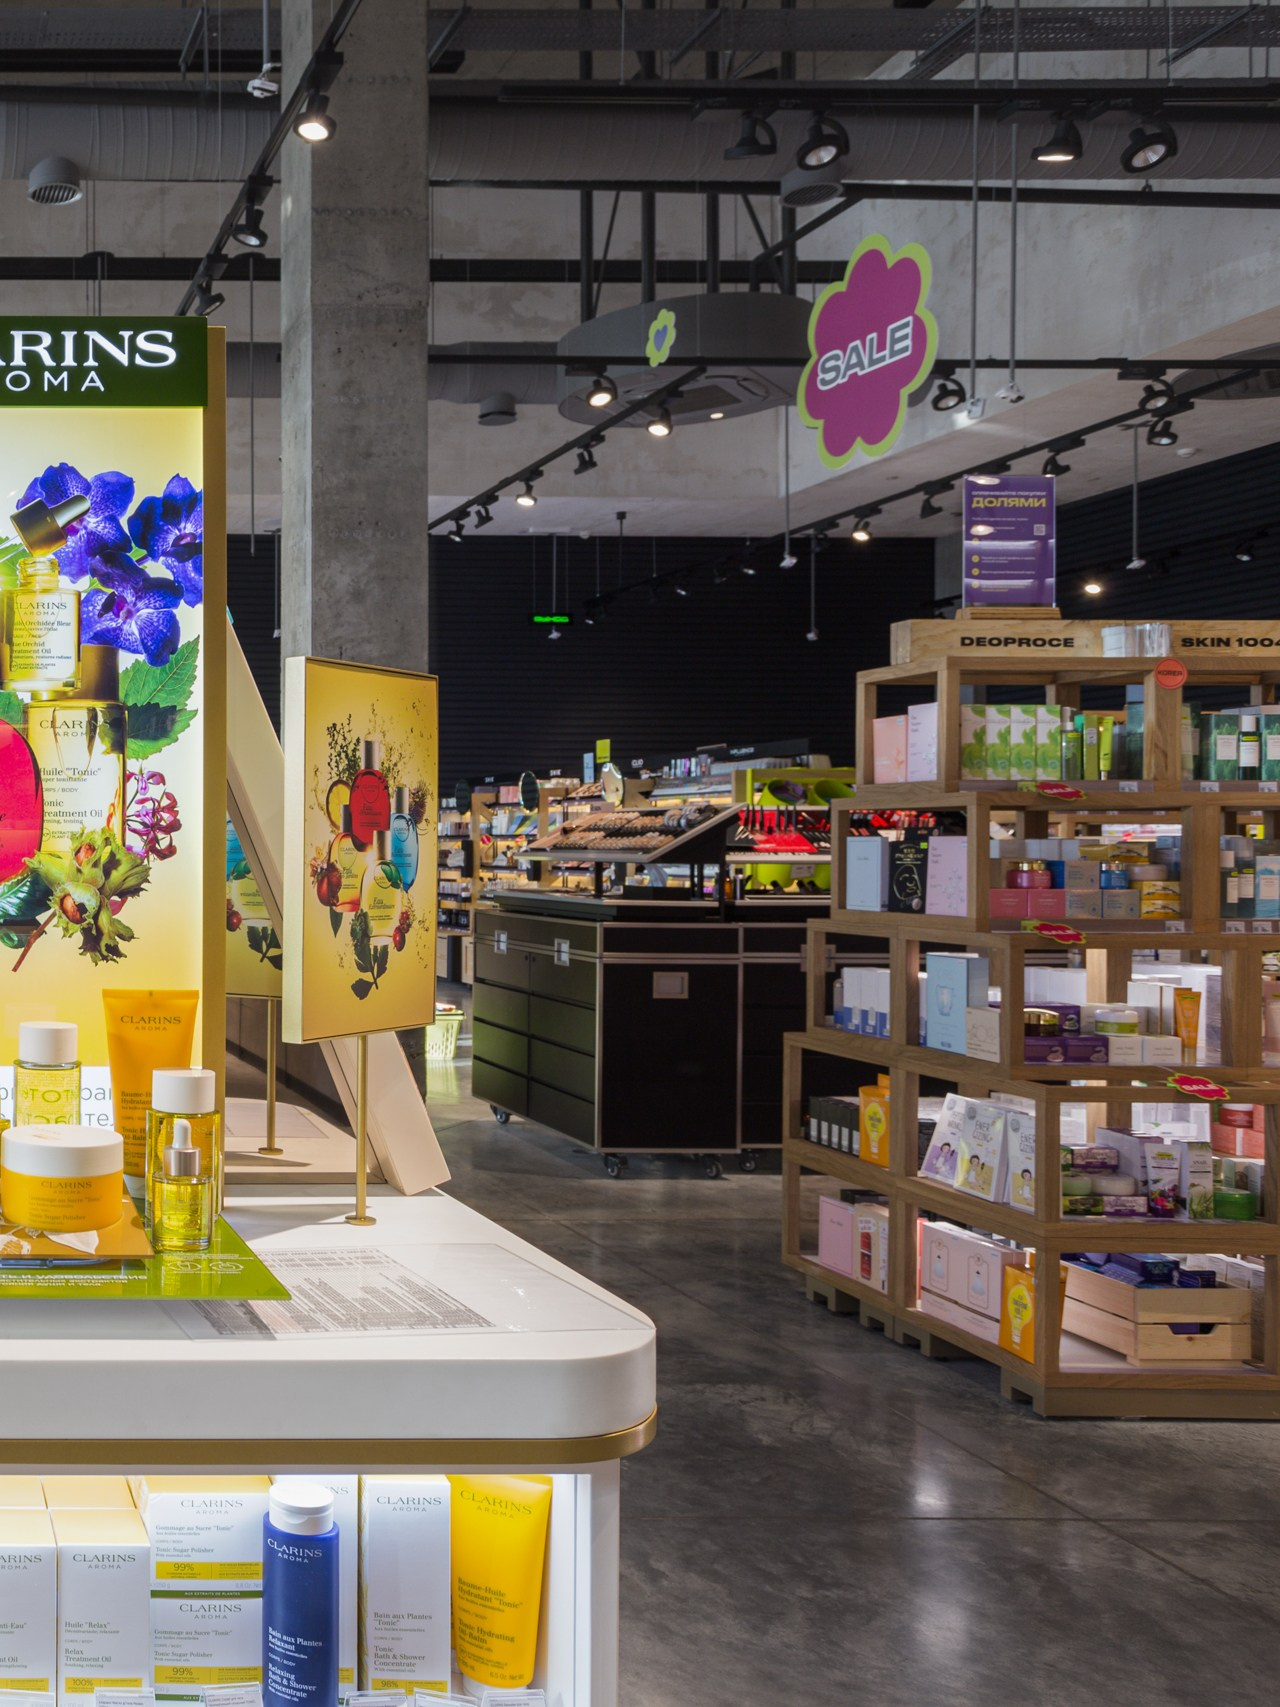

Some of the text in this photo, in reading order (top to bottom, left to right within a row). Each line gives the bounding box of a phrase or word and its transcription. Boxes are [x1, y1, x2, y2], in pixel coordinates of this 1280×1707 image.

[817, 316, 914, 390] SALE
[972, 497, 1046, 508] ДОЛЯМИ
[960, 636, 1075, 648] DEOPROCE
[1180, 637, 1231, 648] SKIN
[43, 799, 64, 807] onic
[44, 809, 103, 818] reatment Oil
[120, 1016, 181, 1025] CLARINS
[41, 1181, 93, 1189] CLARINS
[181, 1500, 243, 1508] CLARINS
[376, 1496, 442, 1506] CLARINS
[460, 1490, 532, 1515] CLARINS
[476, 1506, 514, 1519] AROMA
[267, 1538, 323, 1558] CLARINS
[73, 1554, 136, 1562] CLARINS
[278, 1553, 309, 1564] AROMA
[174, 1564, 195, 1572] 99%
[180, 1604, 242, 1613] CLARINS
[374, 1619, 400, 1627] "Tonic"
[268, 1634, 296, 1651] Relaxant
[374, 1652, 391, 1660] Bath
[400, 1653, 426, 1661] Shower
[374, 1660, 417, 1668] Concentrate
[173, 1668, 193, 1676] 99%
[268, 1663, 296, 1681] Relaxing
[268, 1671, 317, 1692] Bath & Shower
[381, 1680, 398, 1688] 98%
[268, 1679, 308, 1698] Concentrate
